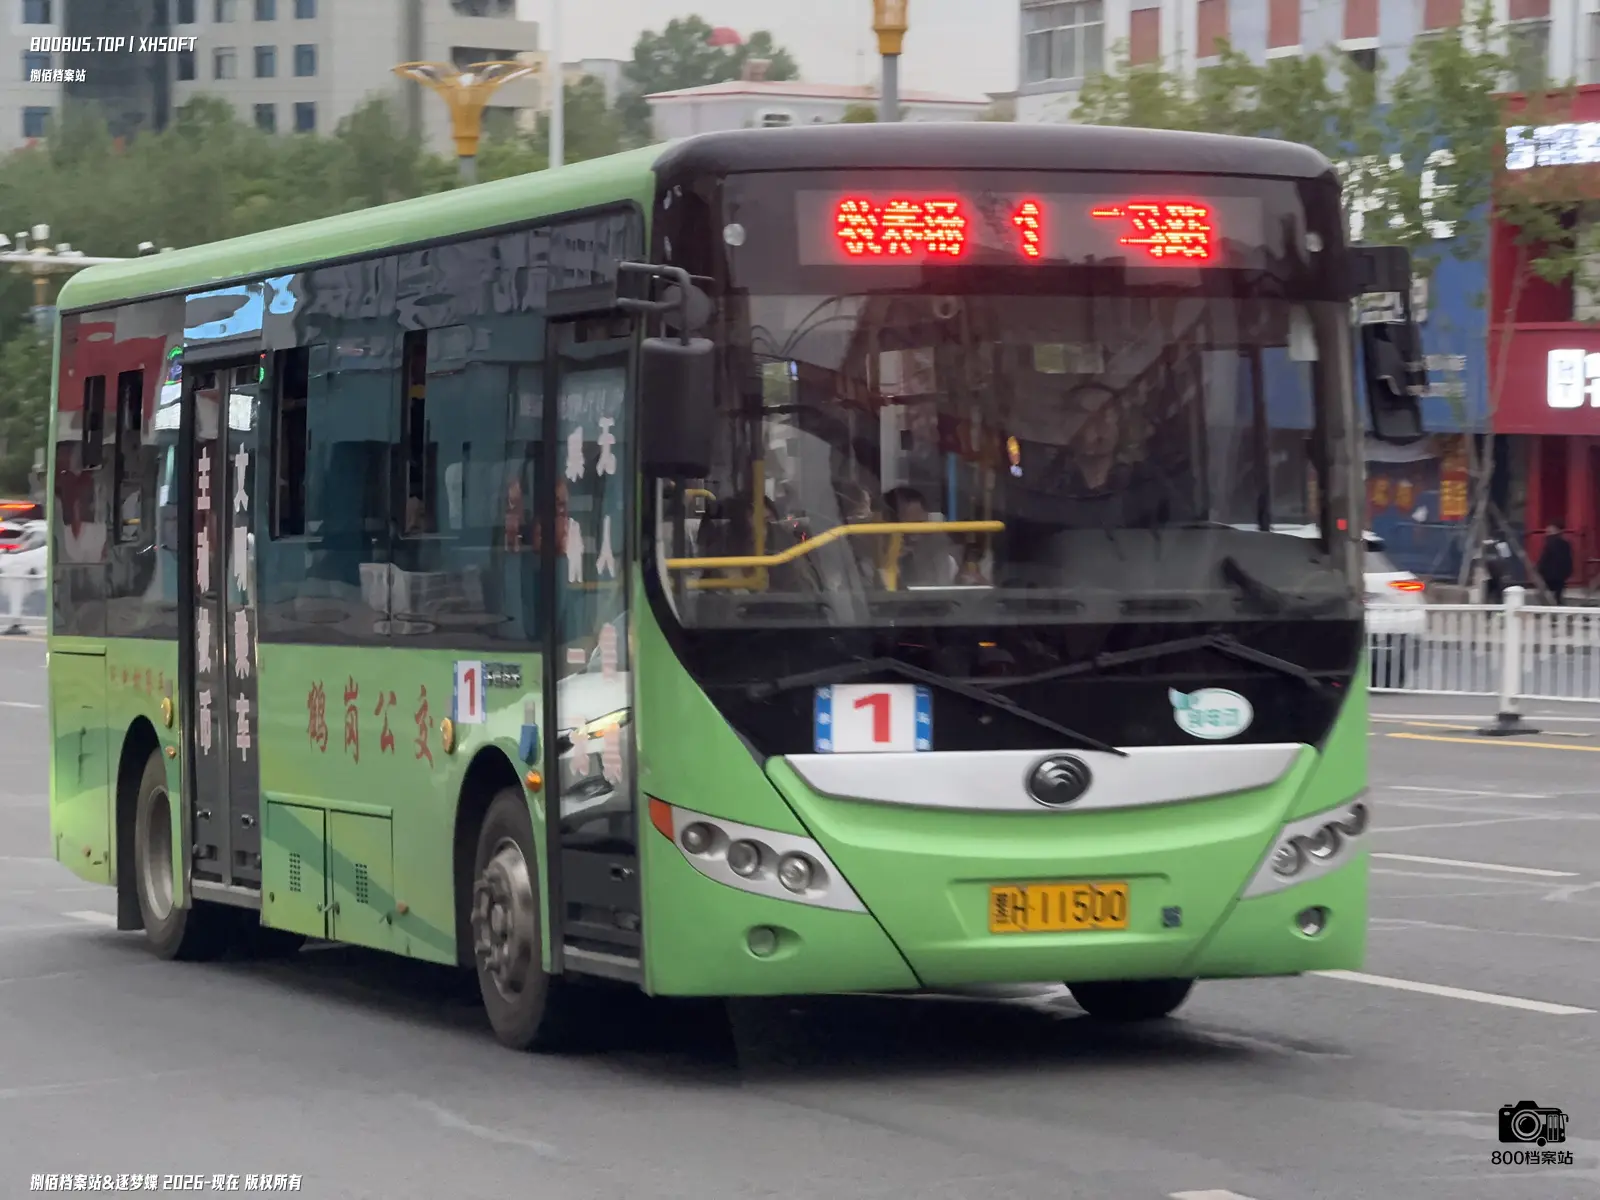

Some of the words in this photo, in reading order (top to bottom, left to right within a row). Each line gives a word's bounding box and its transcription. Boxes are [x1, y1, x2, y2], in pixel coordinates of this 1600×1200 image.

[1013, 203, 1039, 255] 1
[463, 667, 476, 717] 1
[852, 692, 893, 744] 1
[306, 674, 434, 770] 鹤岗公交
